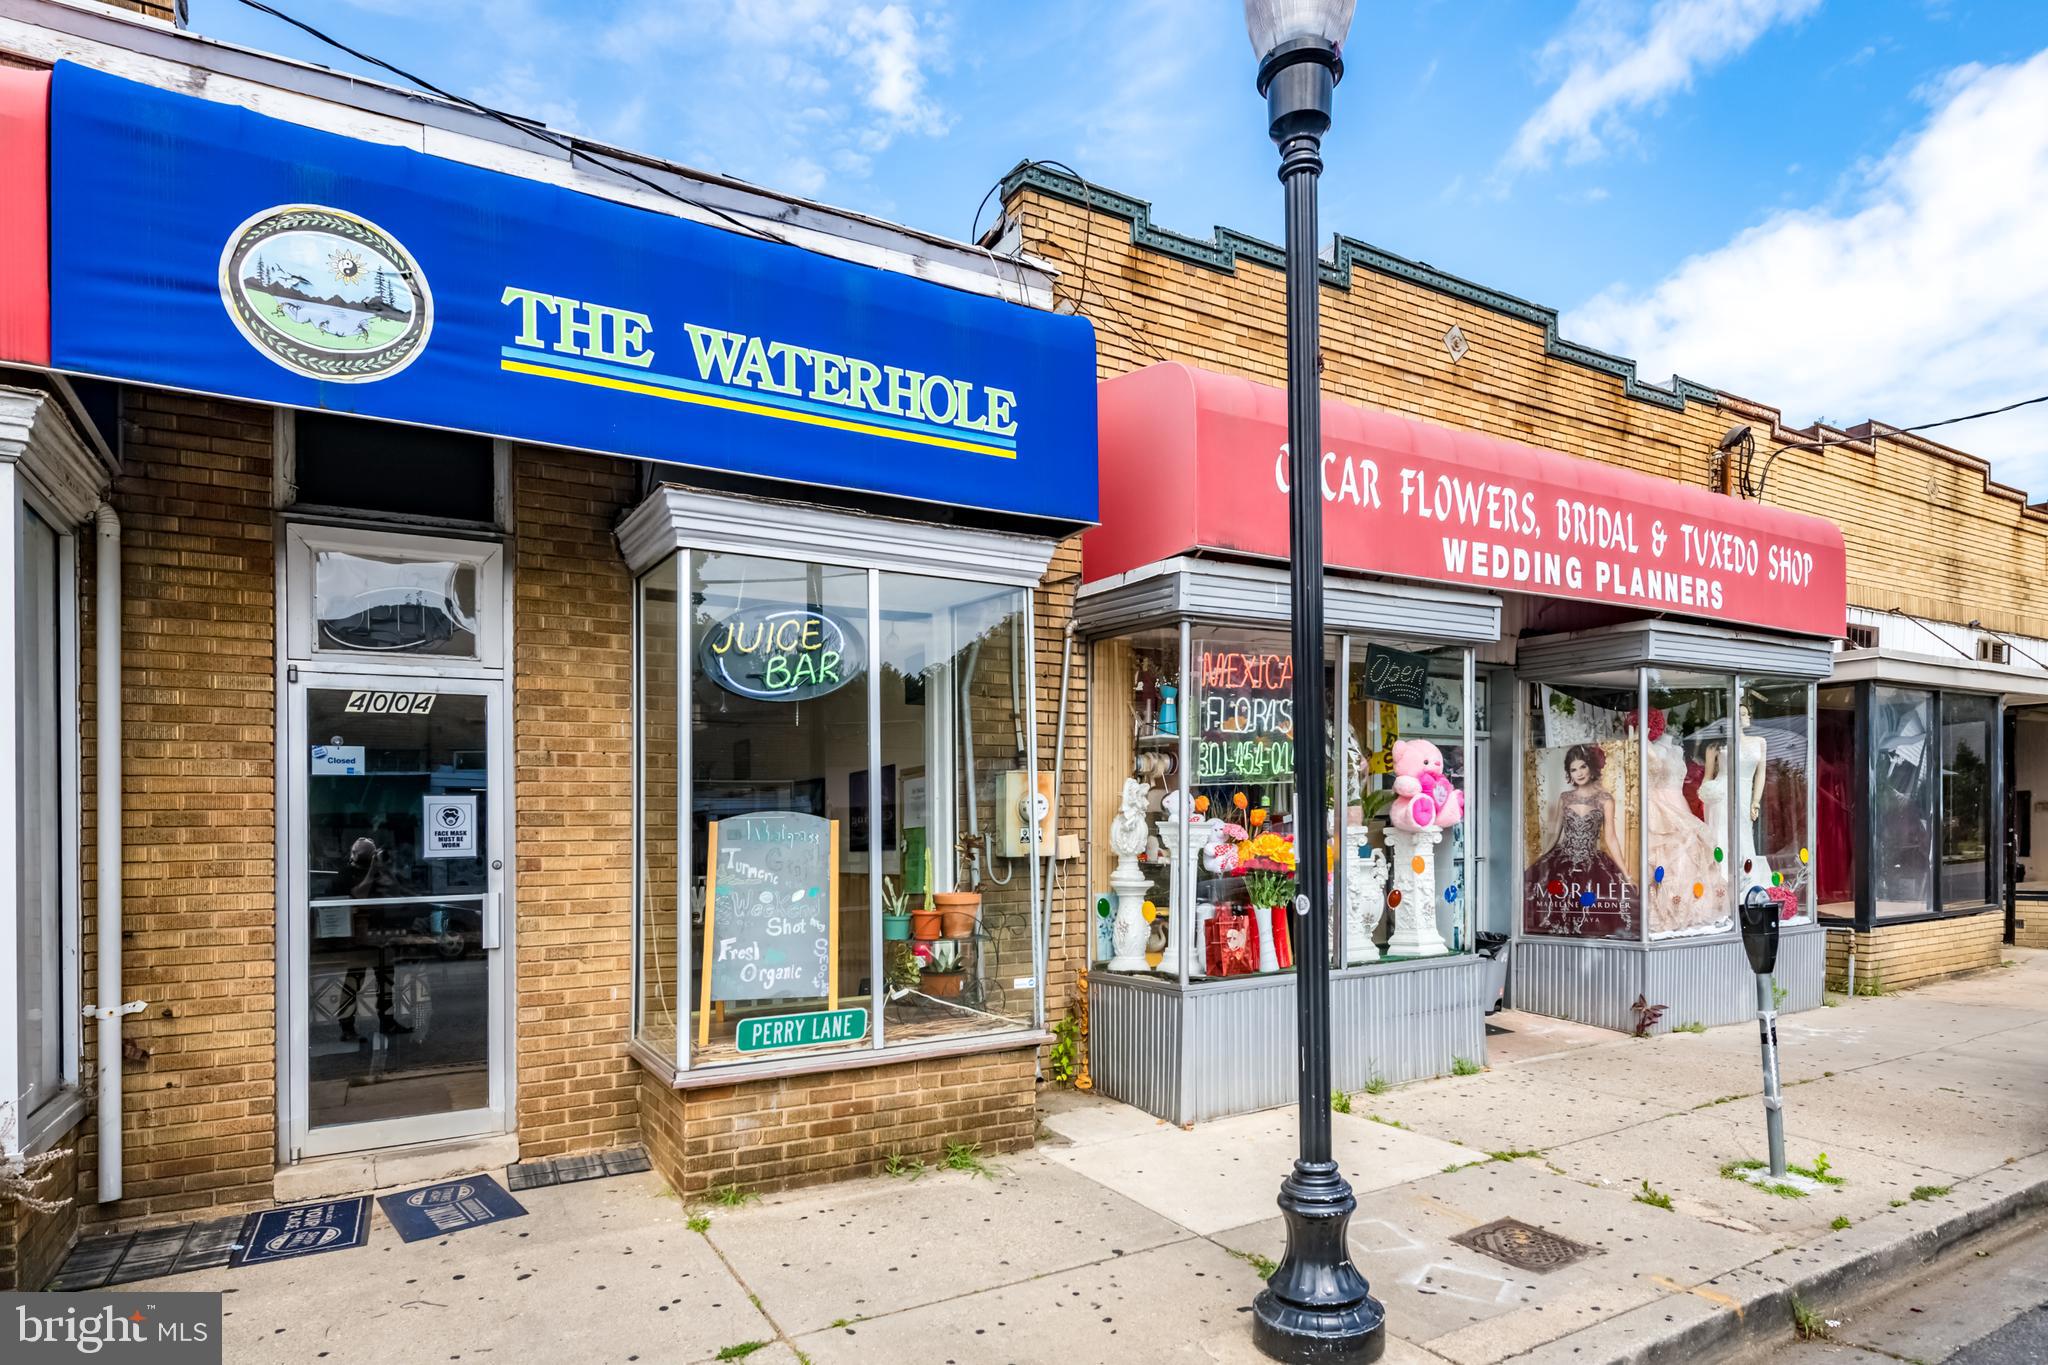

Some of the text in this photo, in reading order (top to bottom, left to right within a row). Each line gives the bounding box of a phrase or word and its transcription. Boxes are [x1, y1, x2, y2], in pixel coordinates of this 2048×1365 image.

[501, 286, 1018, 437] THE WATERHOLE
[1275, 443, 1813, 588] OCAR FLOWERS, BRIDAL & TUXEDO SHOP
[1442, 537, 1723, 609] WEDDING PLANNERS
[712, 619, 822, 654] JUICE
[766, 651, 840, 689] BAR
[1202, 652, 1293, 689] MEXICA
[1369, 653, 1425, 691] Open
[348, 693, 434, 712] 4004
[766, 916, 807, 936] Shot
[740, 962, 802, 990] Organic
[752, 1014, 853, 1046] PERRY LANE
